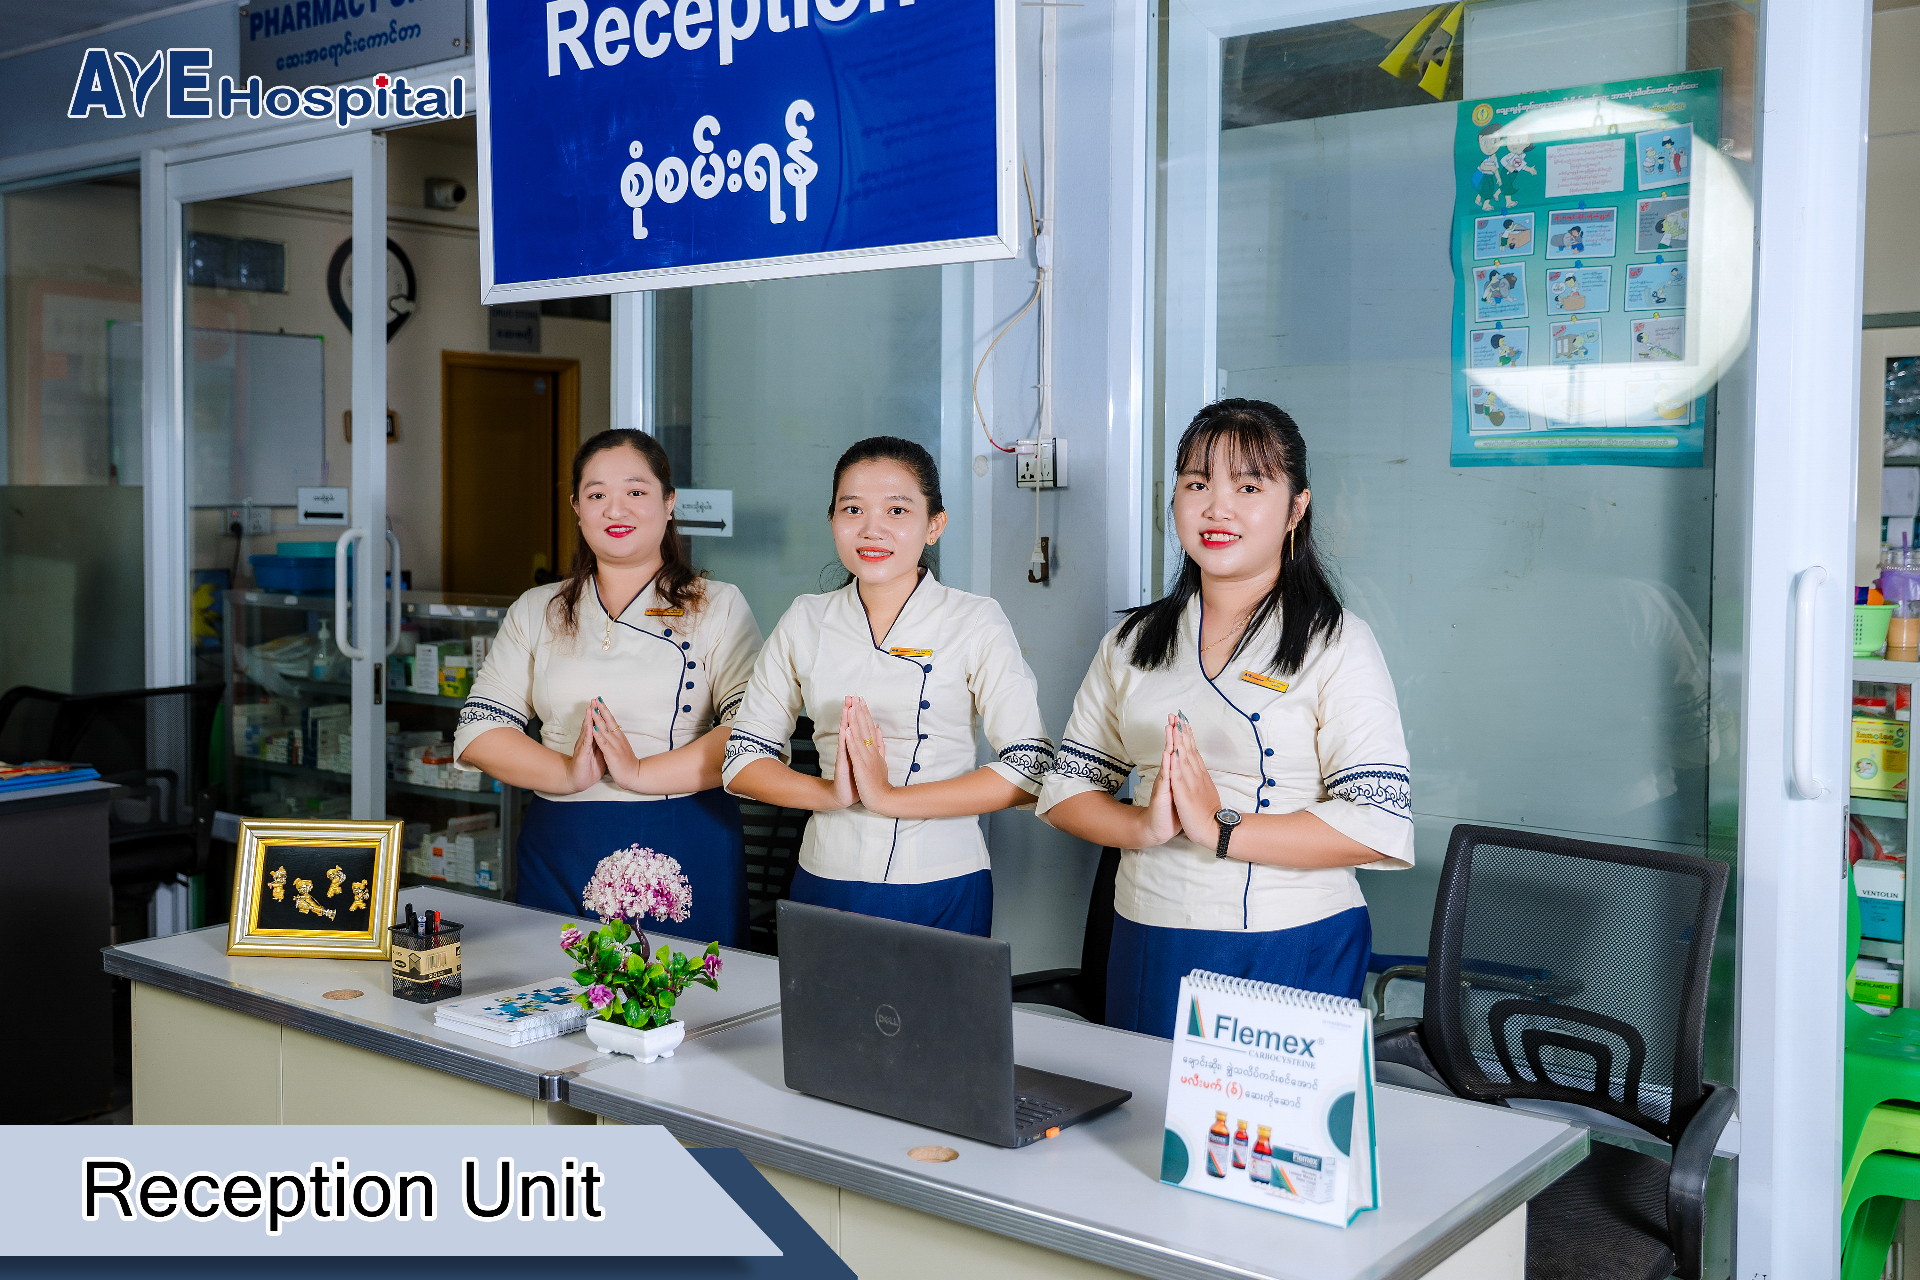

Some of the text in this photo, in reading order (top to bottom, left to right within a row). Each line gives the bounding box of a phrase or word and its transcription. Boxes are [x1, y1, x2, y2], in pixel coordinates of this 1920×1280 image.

[546, 0, 915, 76] Recep
[620, 99, 819, 240] စုံစမ်းရန်
[1862, 889, 1899, 899] VENTOLIN
[878, 1013, 899, 1026] DELL
[1248, 1049, 1317, 1070] CARBOCYSTEINE
